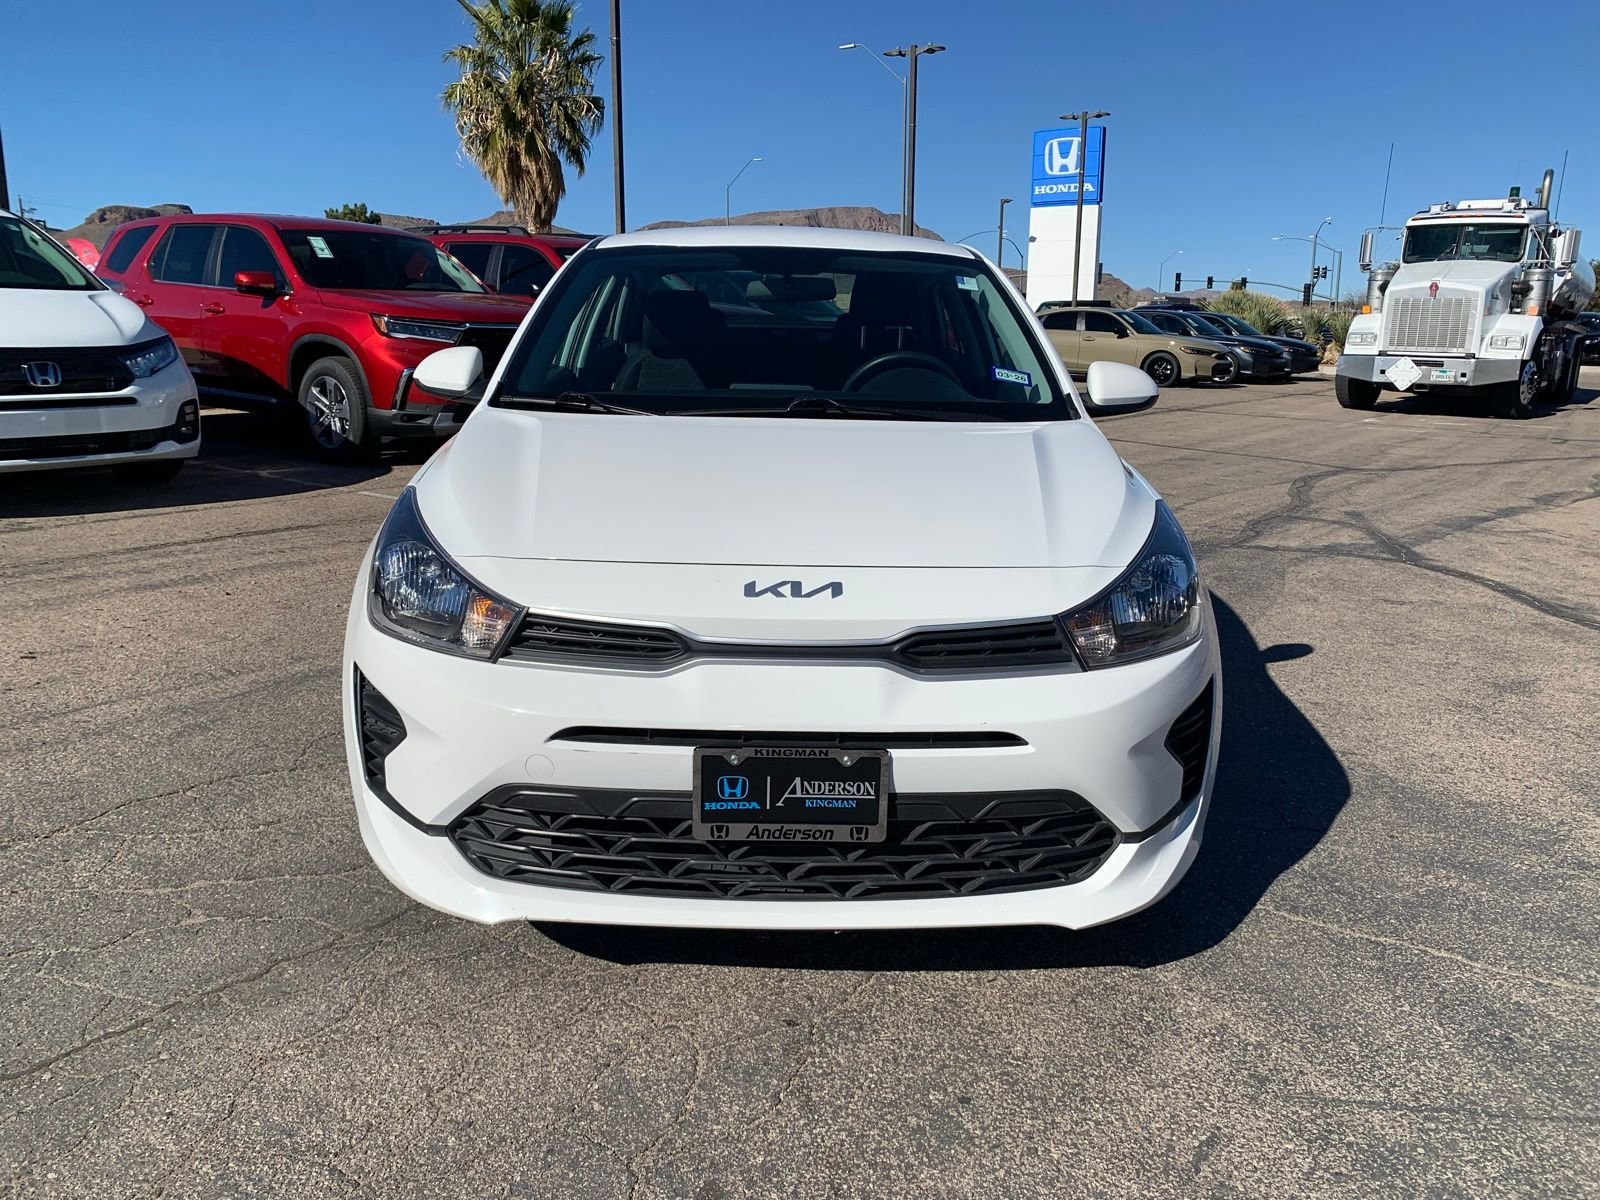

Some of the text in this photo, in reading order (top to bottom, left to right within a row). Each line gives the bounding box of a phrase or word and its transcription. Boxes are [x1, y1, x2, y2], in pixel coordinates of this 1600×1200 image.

[1034, 183, 1095, 194] HONDA
[997, 371, 1027, 382] 03-26
[743, 580, 843, 599] KIA
[754, 749, 829, 757] KINGMAN
[775, 777, 876, 806] ANDERSON
[704, 801, 761, 810] HONDA
[805, 799, 857, 808] KINGMAN
[746, 825, 834, 840] Anderson
